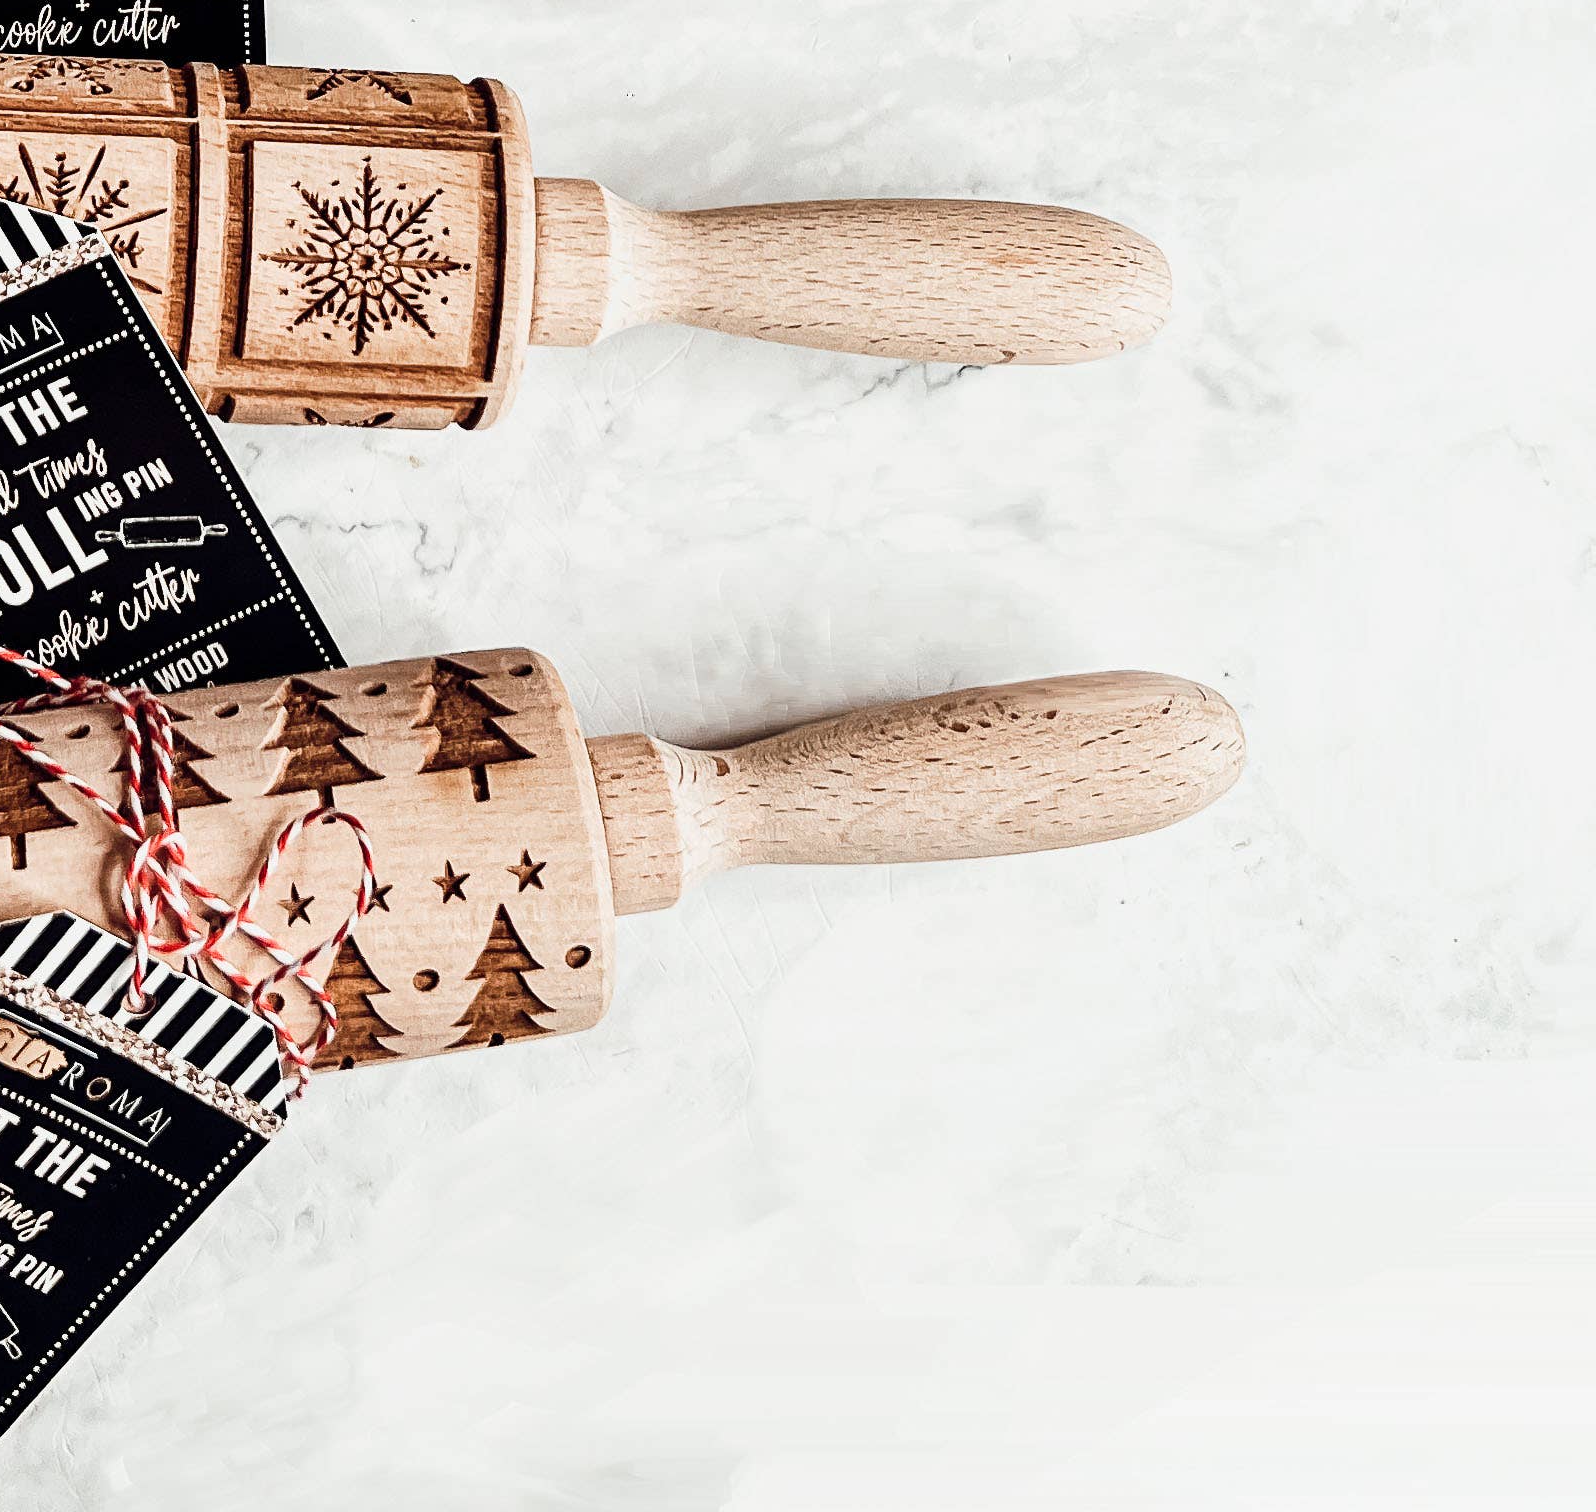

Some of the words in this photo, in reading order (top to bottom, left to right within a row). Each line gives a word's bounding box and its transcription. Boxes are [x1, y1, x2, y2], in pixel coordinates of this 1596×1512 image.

[74, 479, 123, 522] ING
[123, 458, 173, 498] PIN
[118, 561, 200, 631] cutter
[154, 641, 229, 693] WOOD
[14, 1126, 111, 1199] THE
[9, 1253, 65, 1294] PIN
